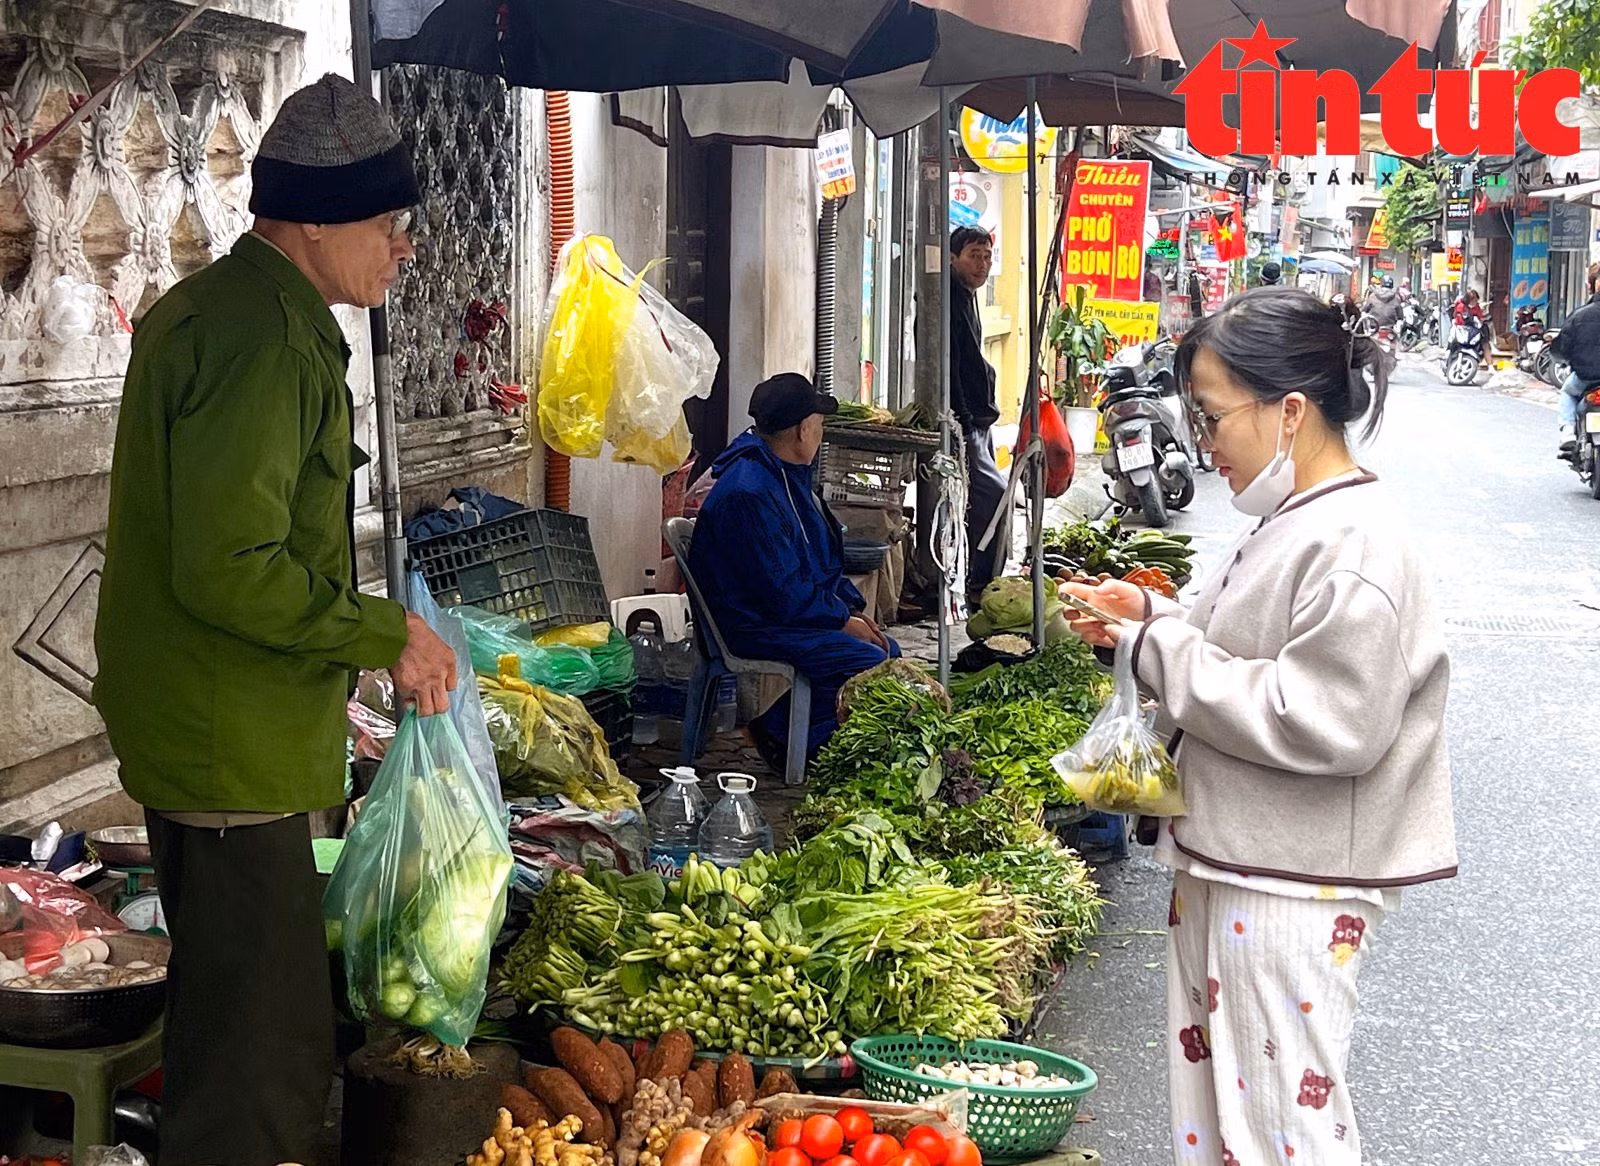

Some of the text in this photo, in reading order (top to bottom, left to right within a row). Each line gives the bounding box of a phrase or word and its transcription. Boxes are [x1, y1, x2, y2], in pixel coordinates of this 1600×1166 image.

[1080, 192, 1134, 206] CHUYÊN
[1068, 211, 1113, 242] PHỞ
[1066, 246, 1112, 275] BÚN
[1116, 240, 1140, 280] BÒ
